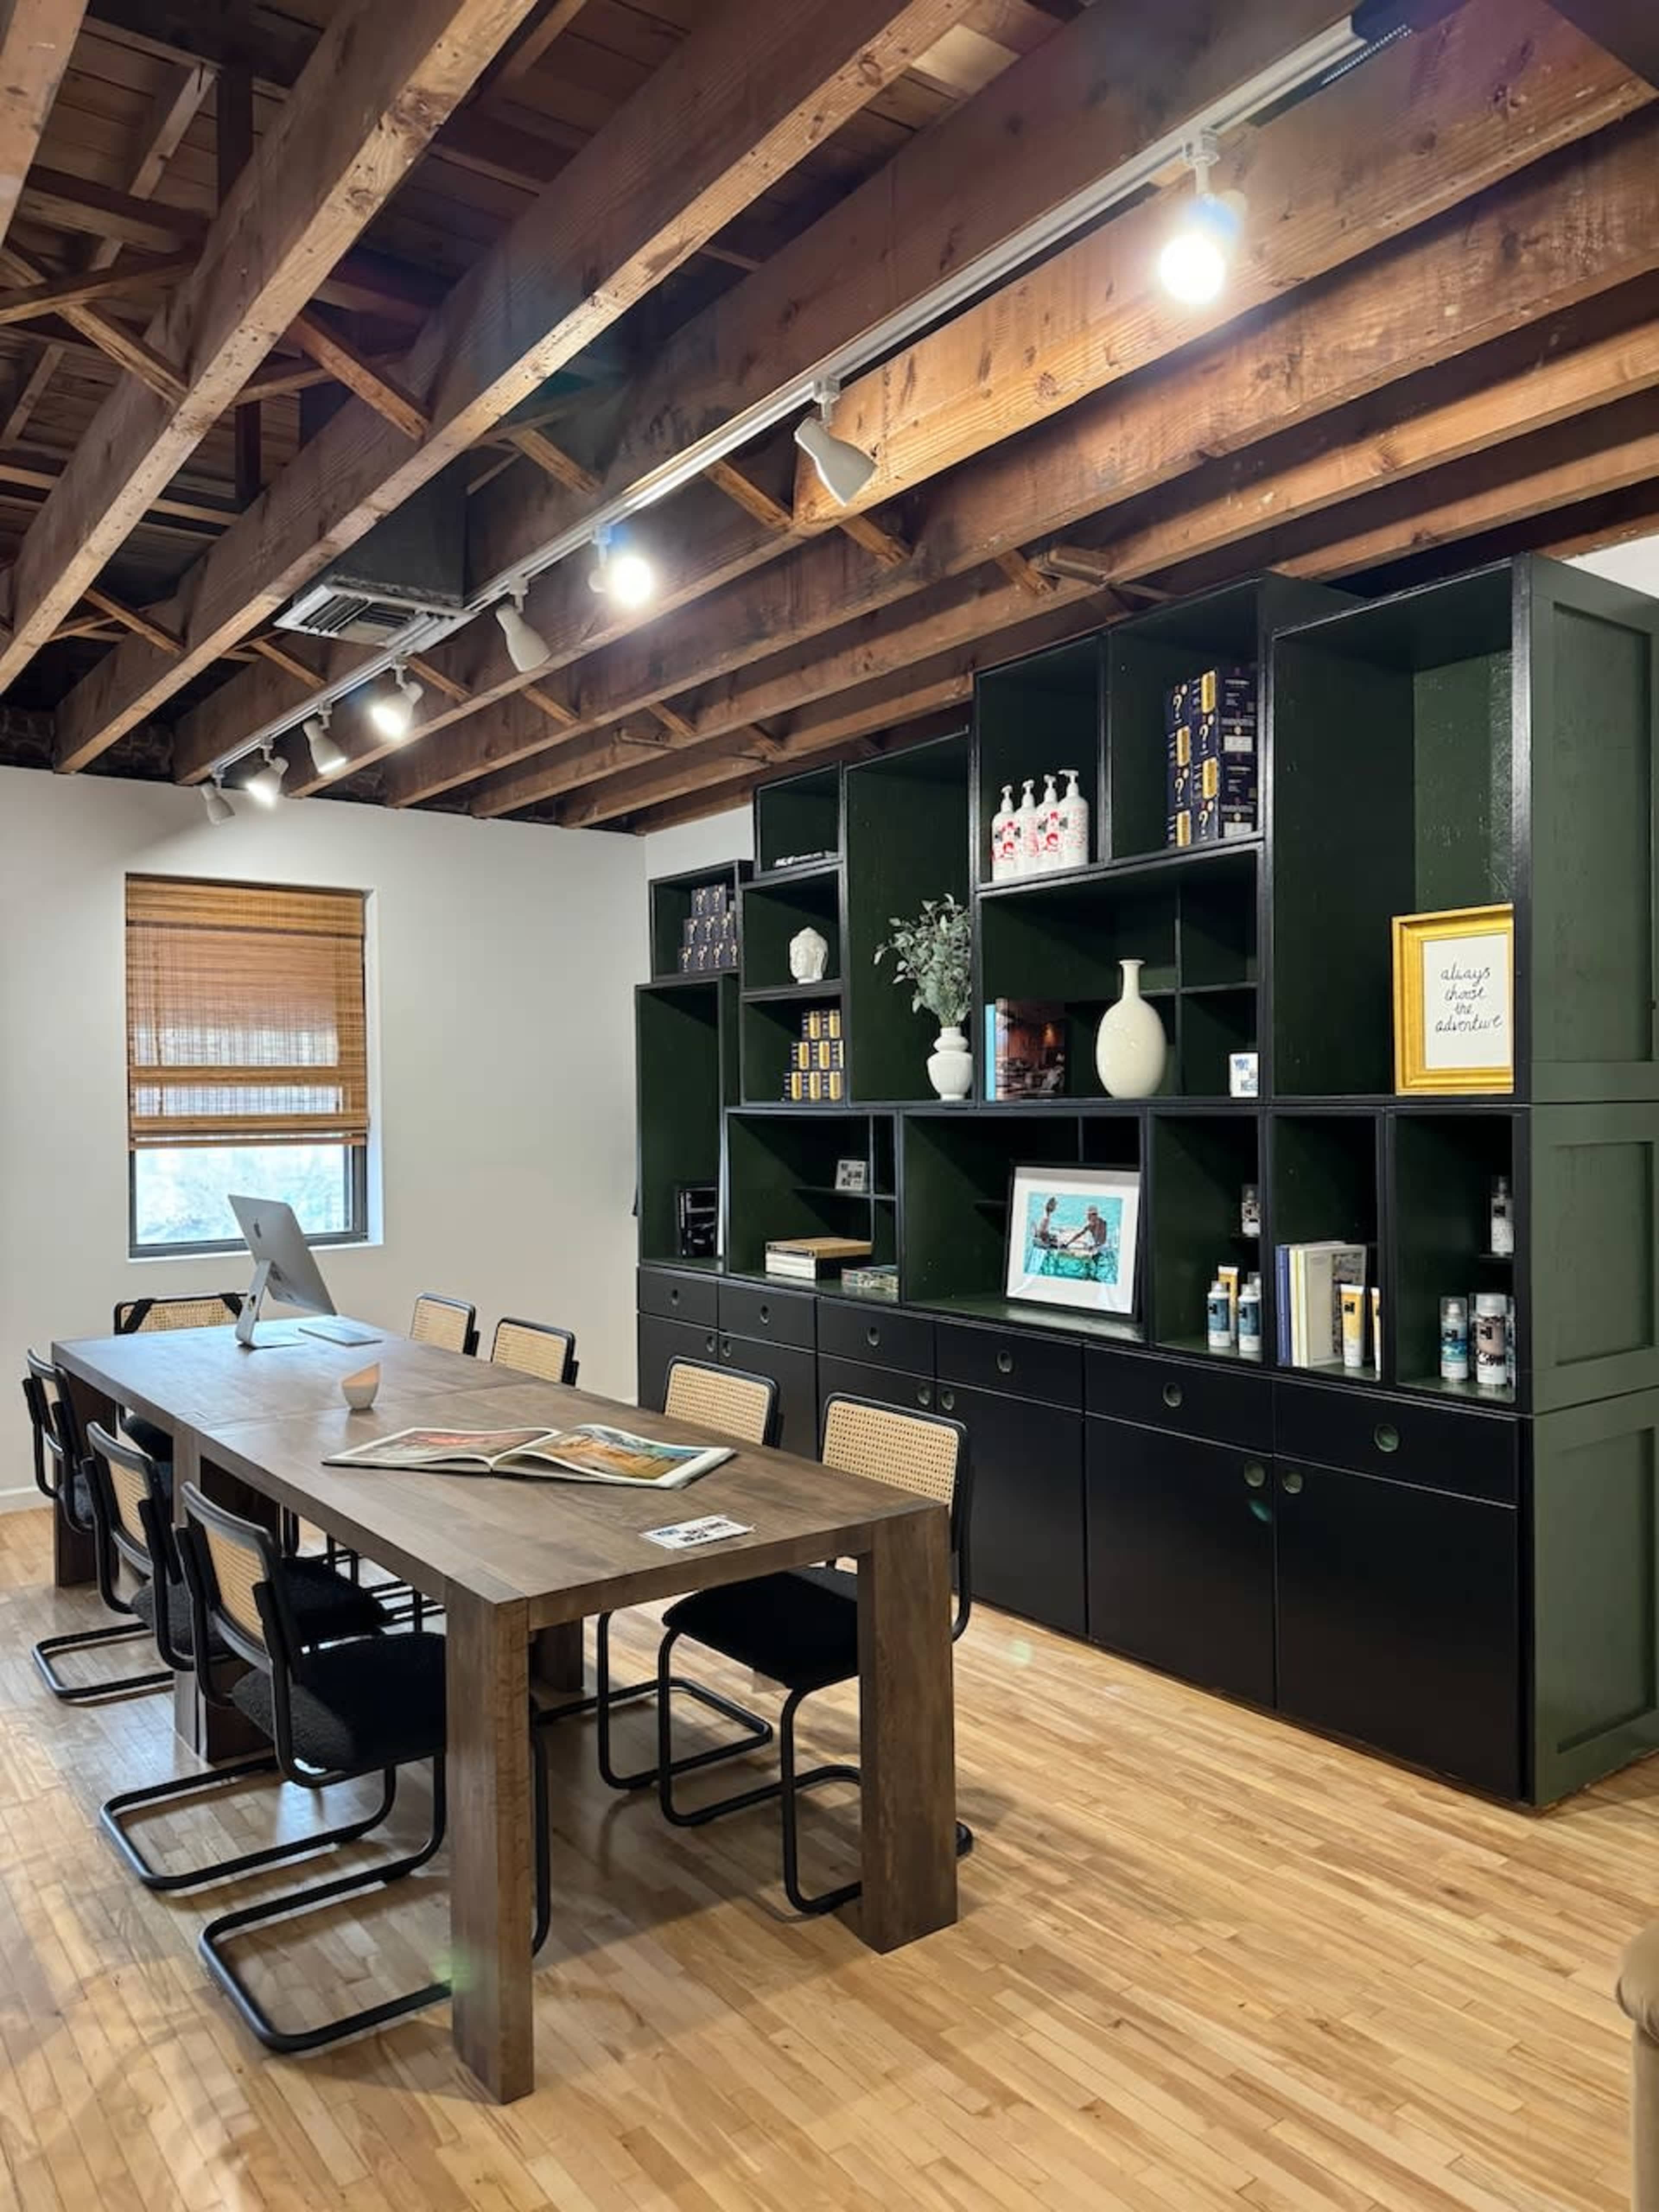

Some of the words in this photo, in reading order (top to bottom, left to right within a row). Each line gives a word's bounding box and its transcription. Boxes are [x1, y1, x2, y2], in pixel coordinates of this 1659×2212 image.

[1440, 962, 1491, 987] always
[1445, 983, 1487, 1001] choose
[1455, 1003, 1475, 1015] the
[1435, 1014, 1503, 1032] adventure
